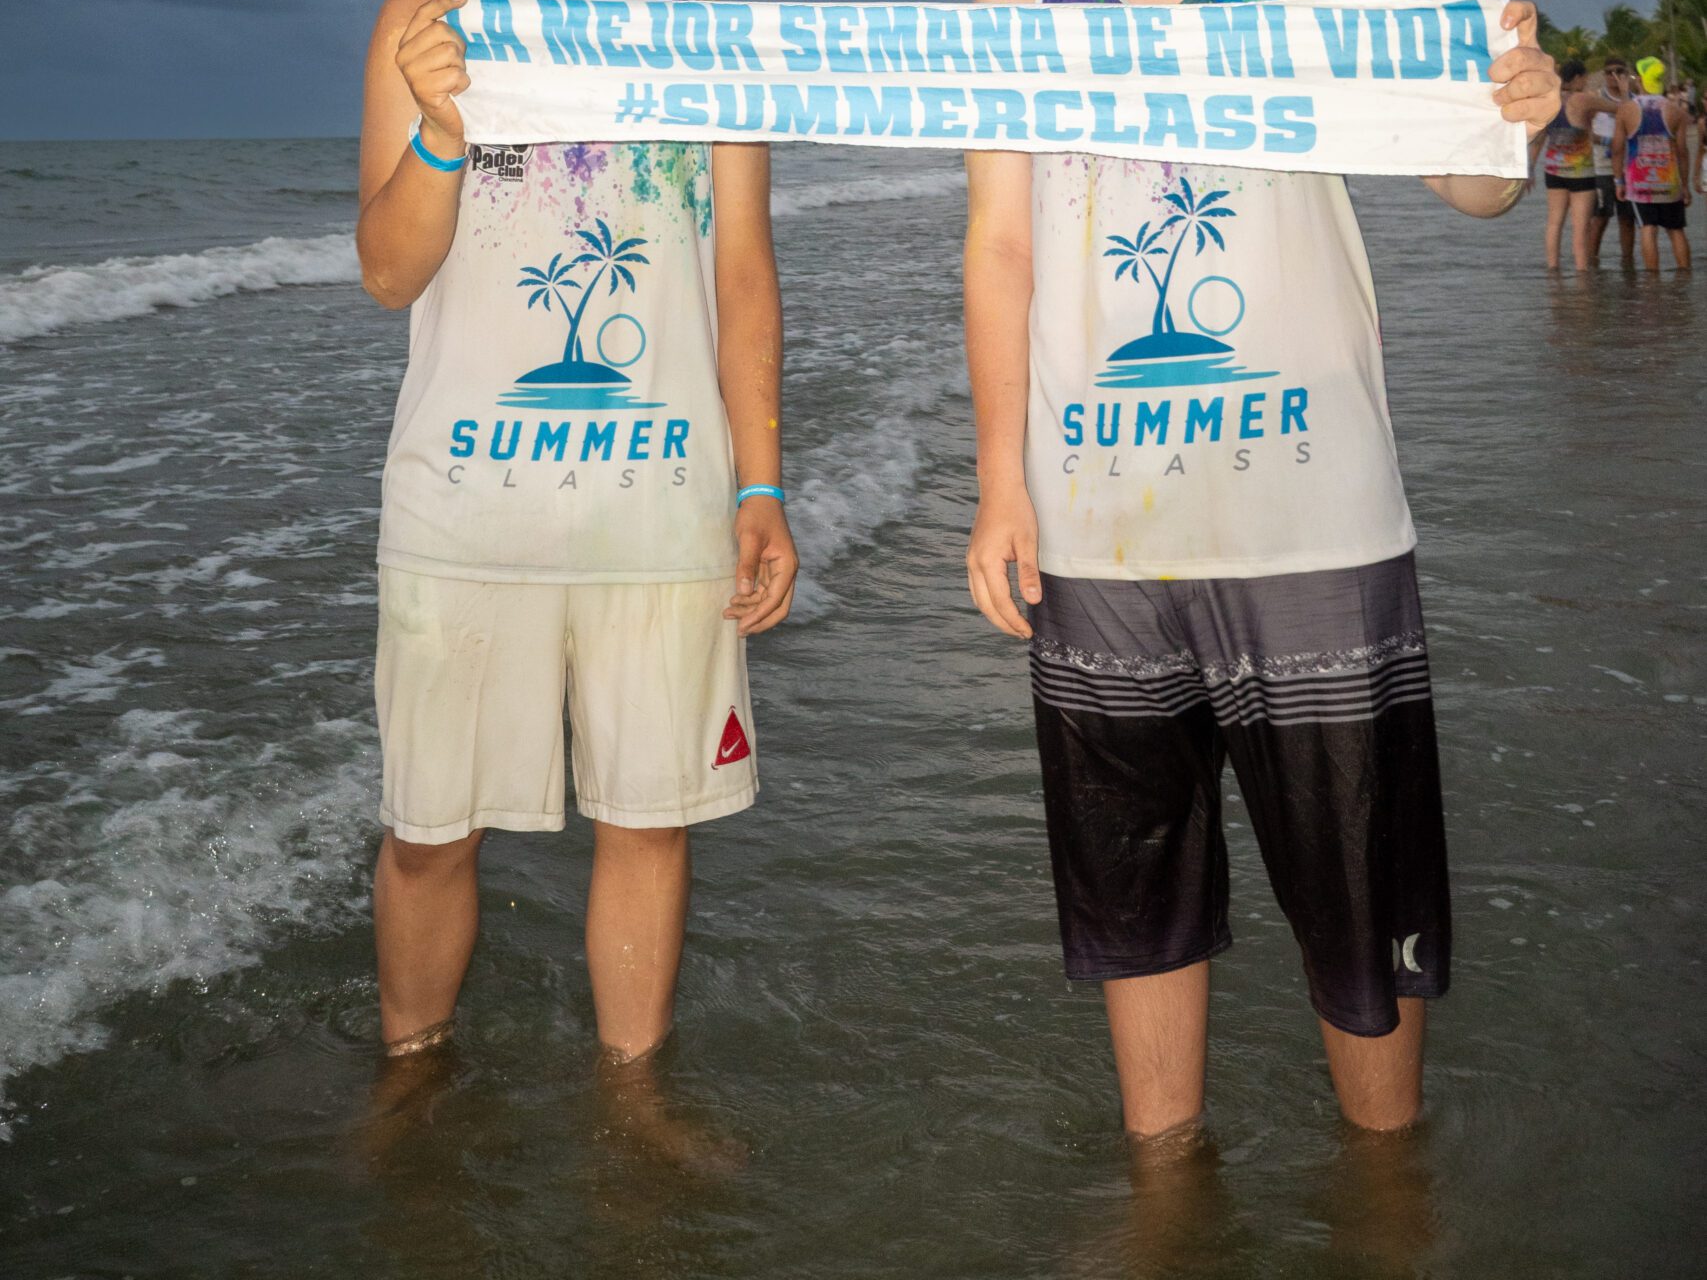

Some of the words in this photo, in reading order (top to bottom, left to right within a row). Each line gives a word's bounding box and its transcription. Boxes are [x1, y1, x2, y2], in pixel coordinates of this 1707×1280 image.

[779, 4, 1066, 73] SEMANA
[1088, 6, 1181, 76] DE
[1200, 5, 1295, 78] MI
[1312, 0, 1492, 83] VIDA
[614, 83, 1317, 154] #SUMMERCLASS
[498, 165, 523, 177] club
[1063, 387, 1308, 447] SUMMER
[450, 419, 690, 461] SUMMER
[1062, 442, 1311, 477] CLASS
[448, 465, 687, 490] CLASS
